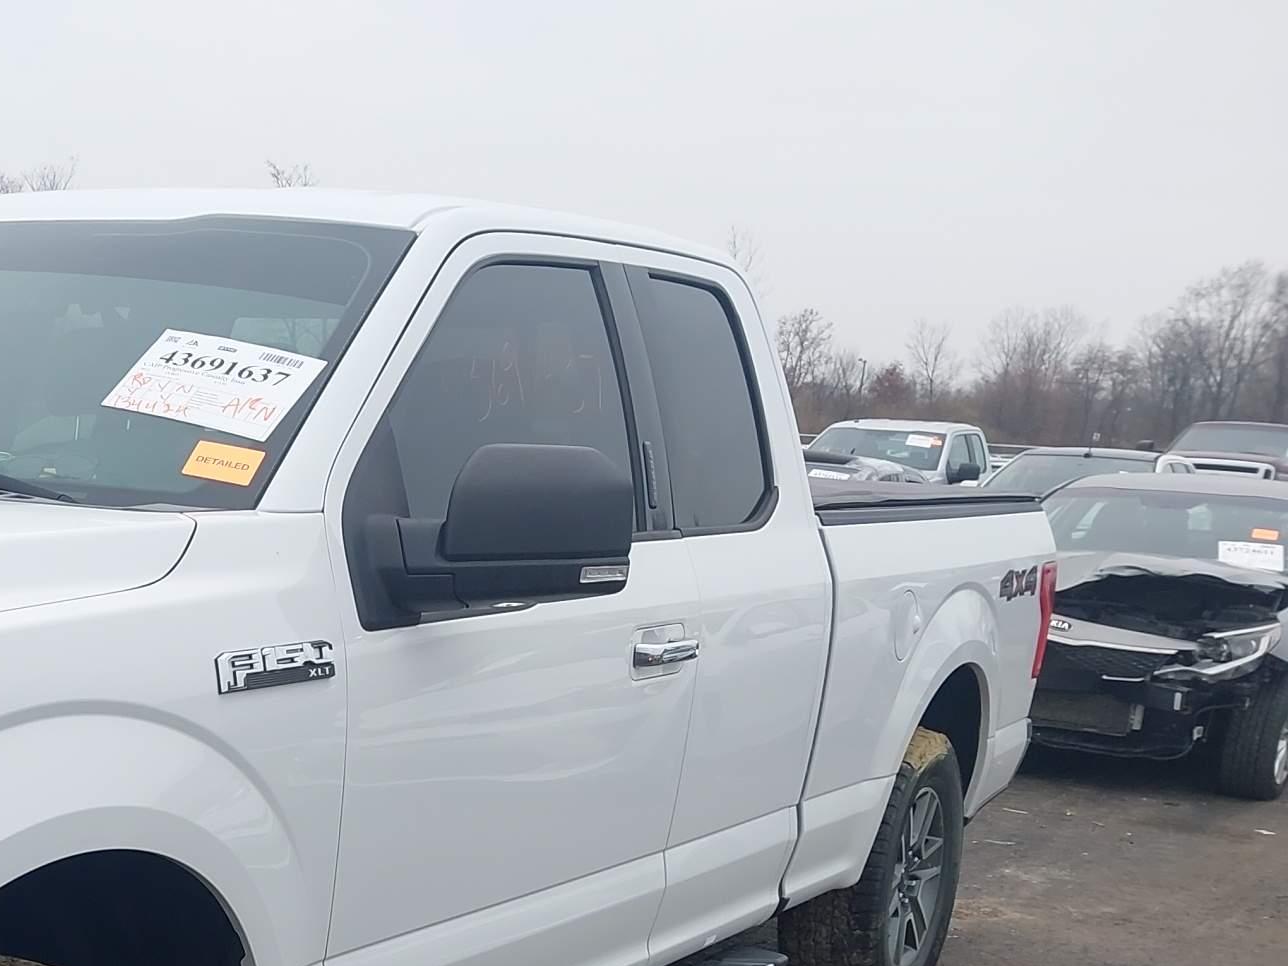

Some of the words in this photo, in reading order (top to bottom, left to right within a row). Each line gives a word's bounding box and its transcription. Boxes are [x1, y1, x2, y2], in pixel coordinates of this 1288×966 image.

[159, 350, 291, 386] 43691637
[195, 455, 250, 471] DETAILED
[1049, 618, 1070, 631] KIA
[308, 666, 331, 678] XLT
